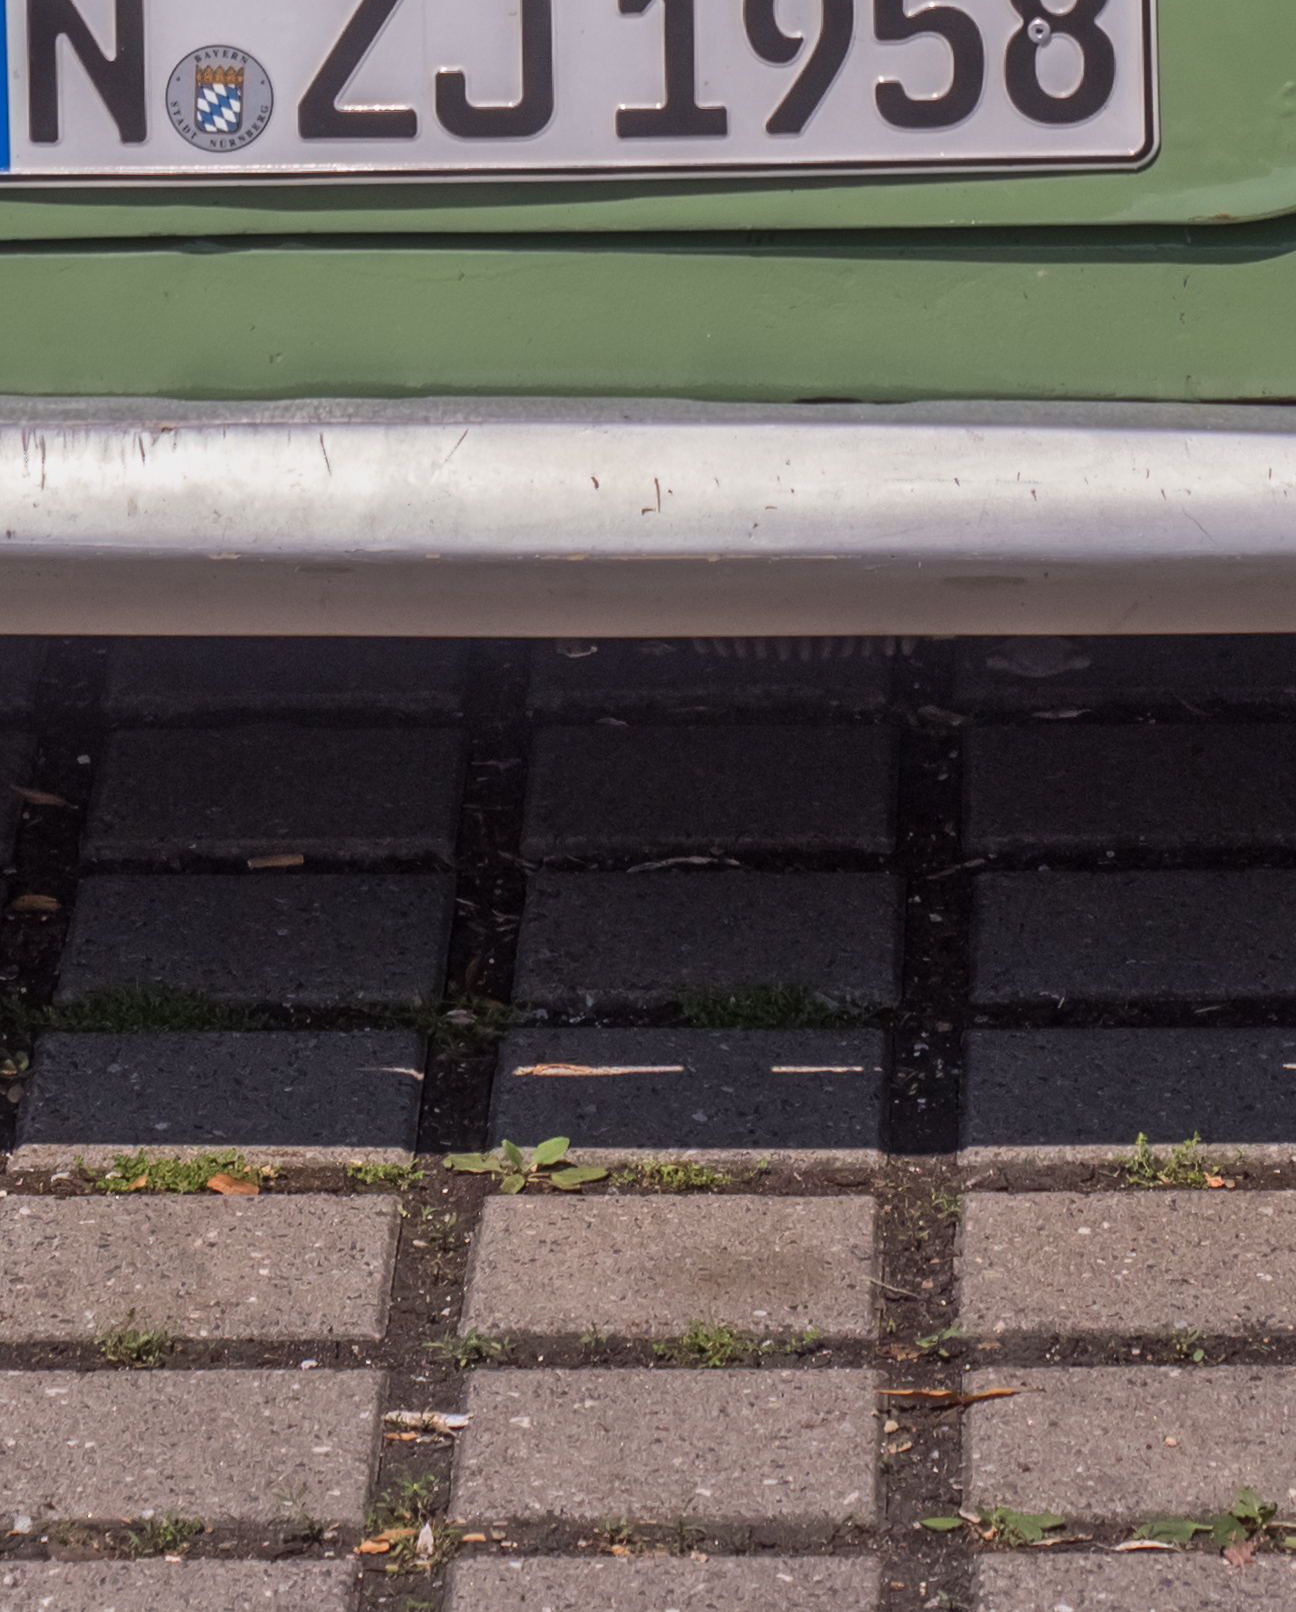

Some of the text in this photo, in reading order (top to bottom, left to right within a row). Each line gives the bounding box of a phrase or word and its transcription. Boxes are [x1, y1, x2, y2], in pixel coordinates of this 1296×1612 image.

[194, 49, 248, 63] BAYERN
[170, 101, 269, 148] STADT NÜRNBERG
